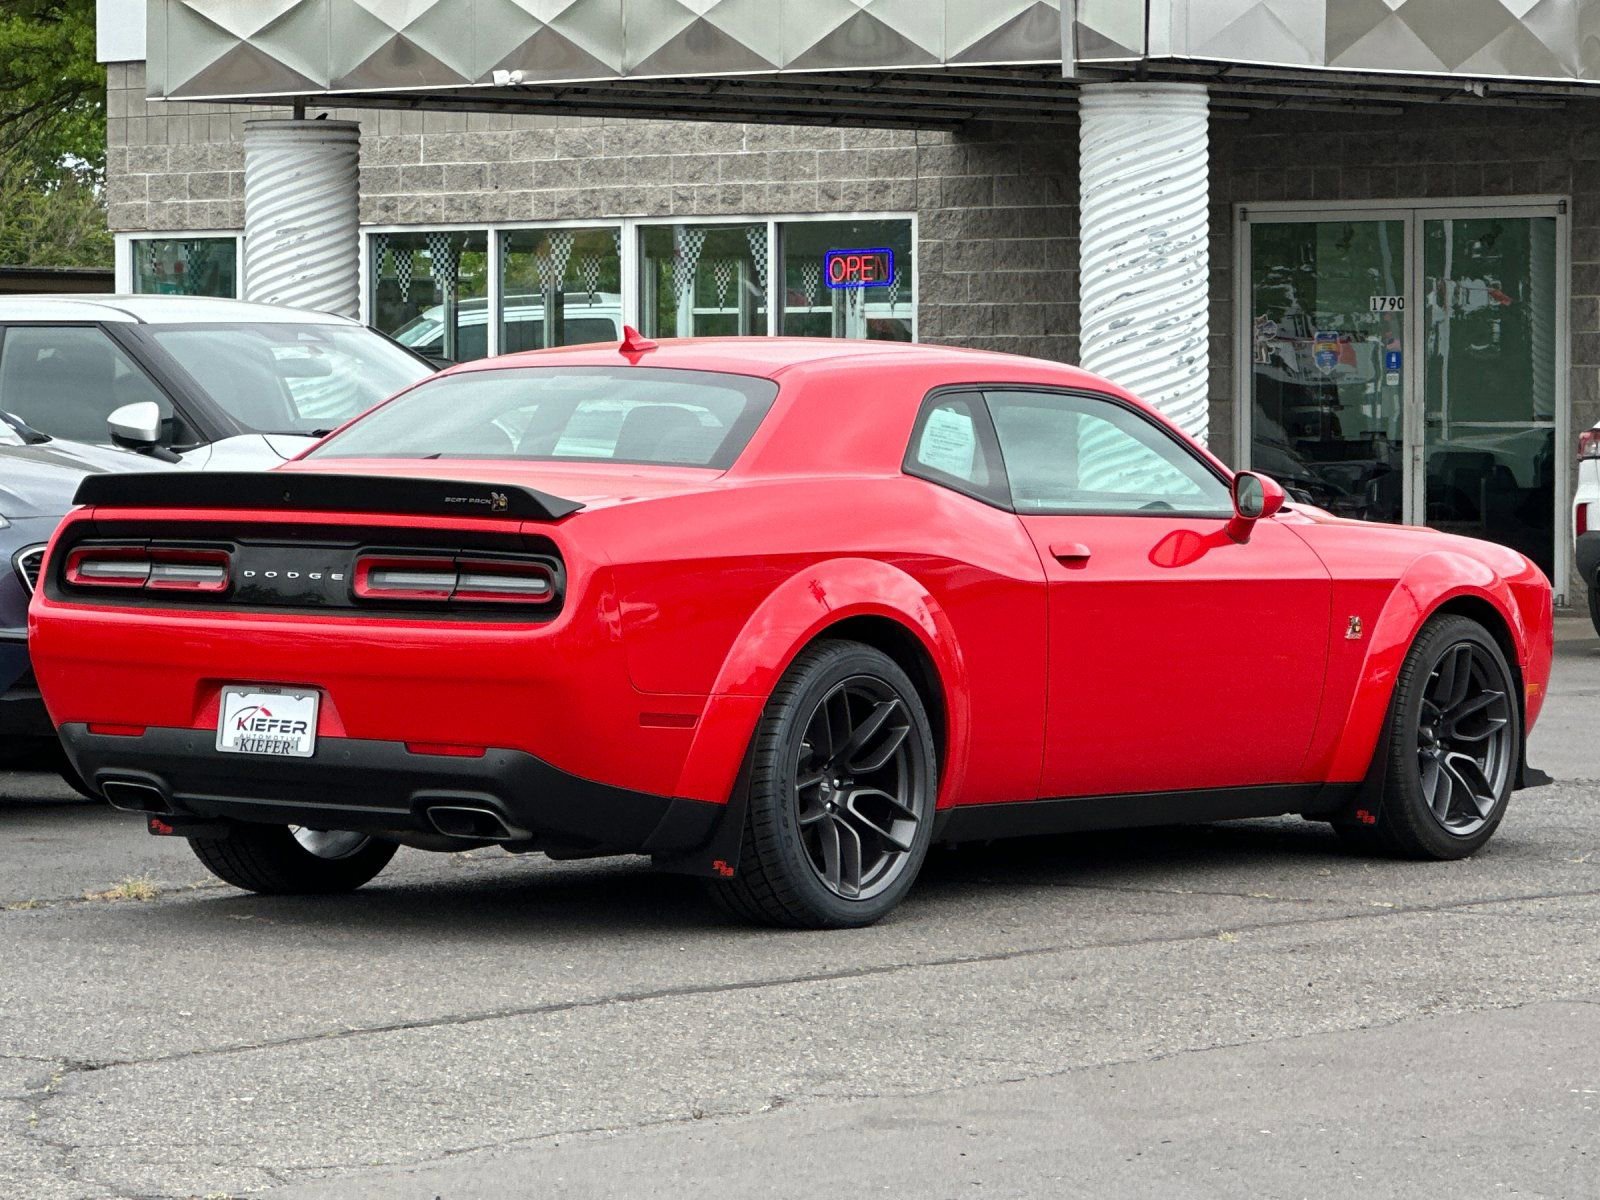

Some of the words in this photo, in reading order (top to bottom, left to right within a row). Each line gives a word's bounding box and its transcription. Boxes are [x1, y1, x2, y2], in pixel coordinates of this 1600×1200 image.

[829, 255, 888, 281] OPEN
[1371, 298, 1404, 310] 1790
[468, 497, 493, 505] PACK
[243, 570, 344, 581] DODGE
[237, 717, 307, 735] KIEFER
[239, 738, 290, 754] KIEFER
